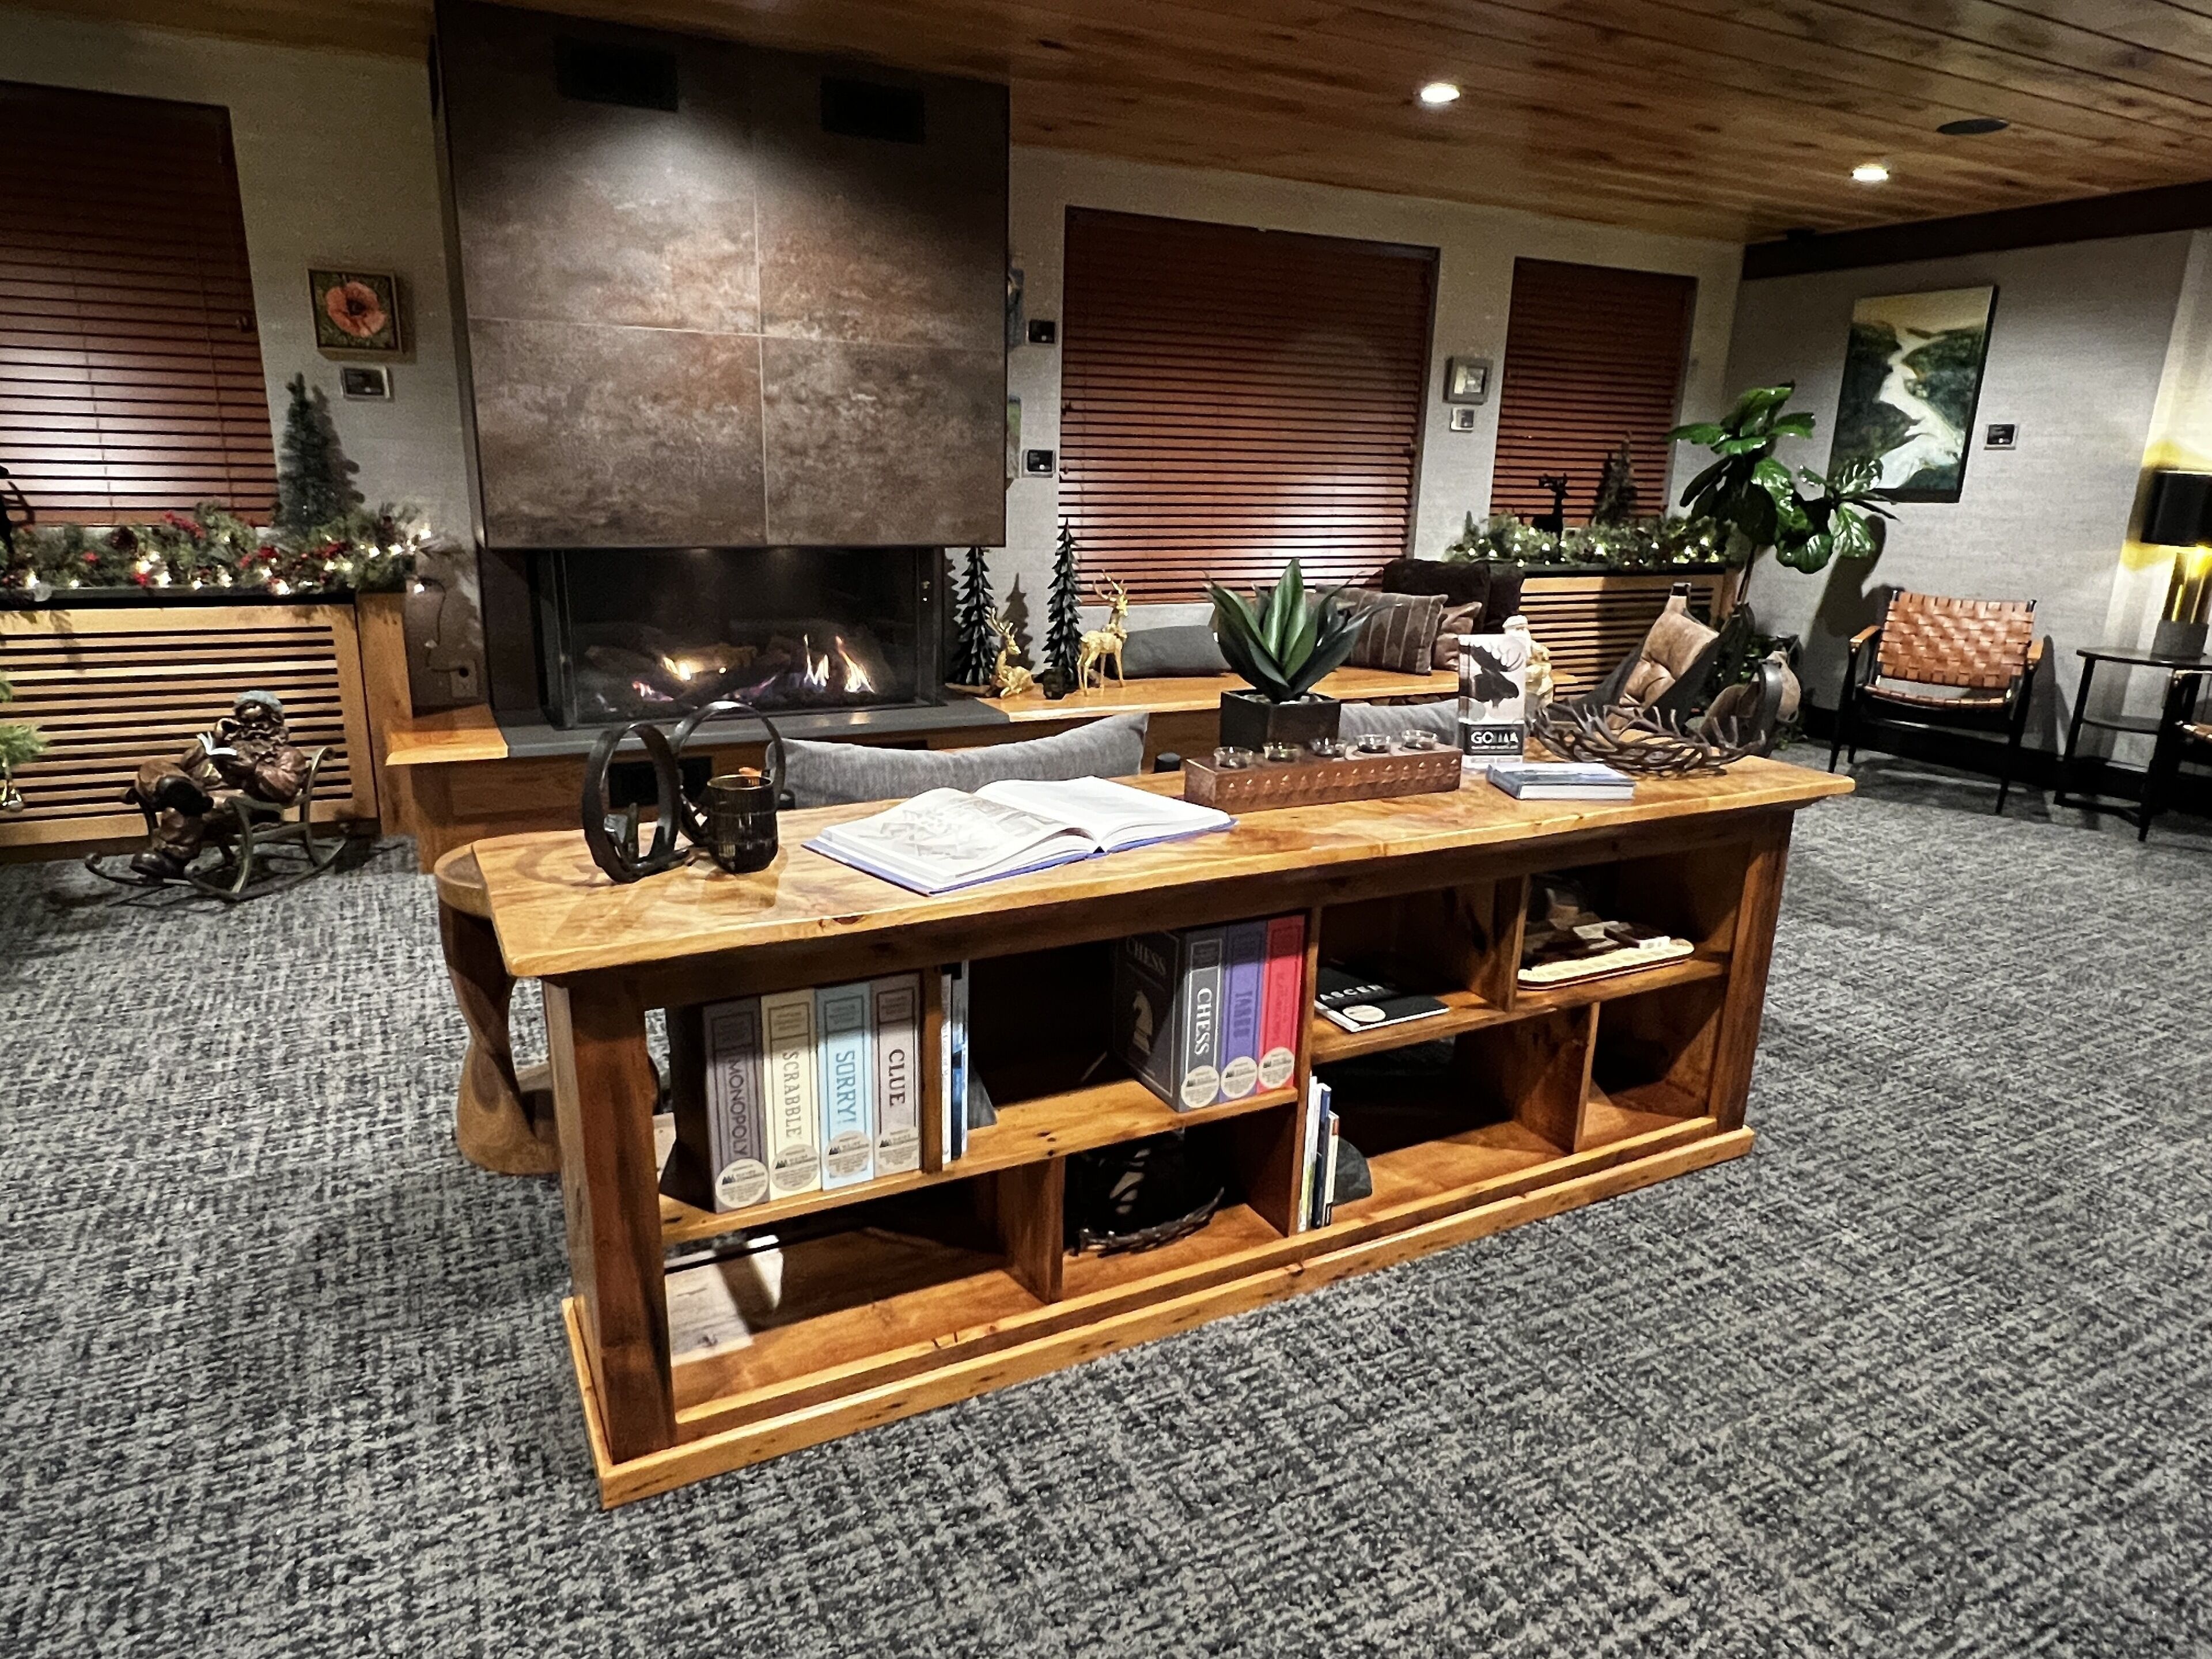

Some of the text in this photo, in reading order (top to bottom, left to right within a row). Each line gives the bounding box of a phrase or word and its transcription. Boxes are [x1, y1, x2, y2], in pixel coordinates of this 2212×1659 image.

[1194, 987, 1213, 1055] CHESS
[728, 1058, 747, 1156] MONOPOLY
[782, 1051, 802, 1139] SCRABBLE
[835, 1050, 857, 1124] SORRY!
[888, 1049, 906, 1106] CLUE
